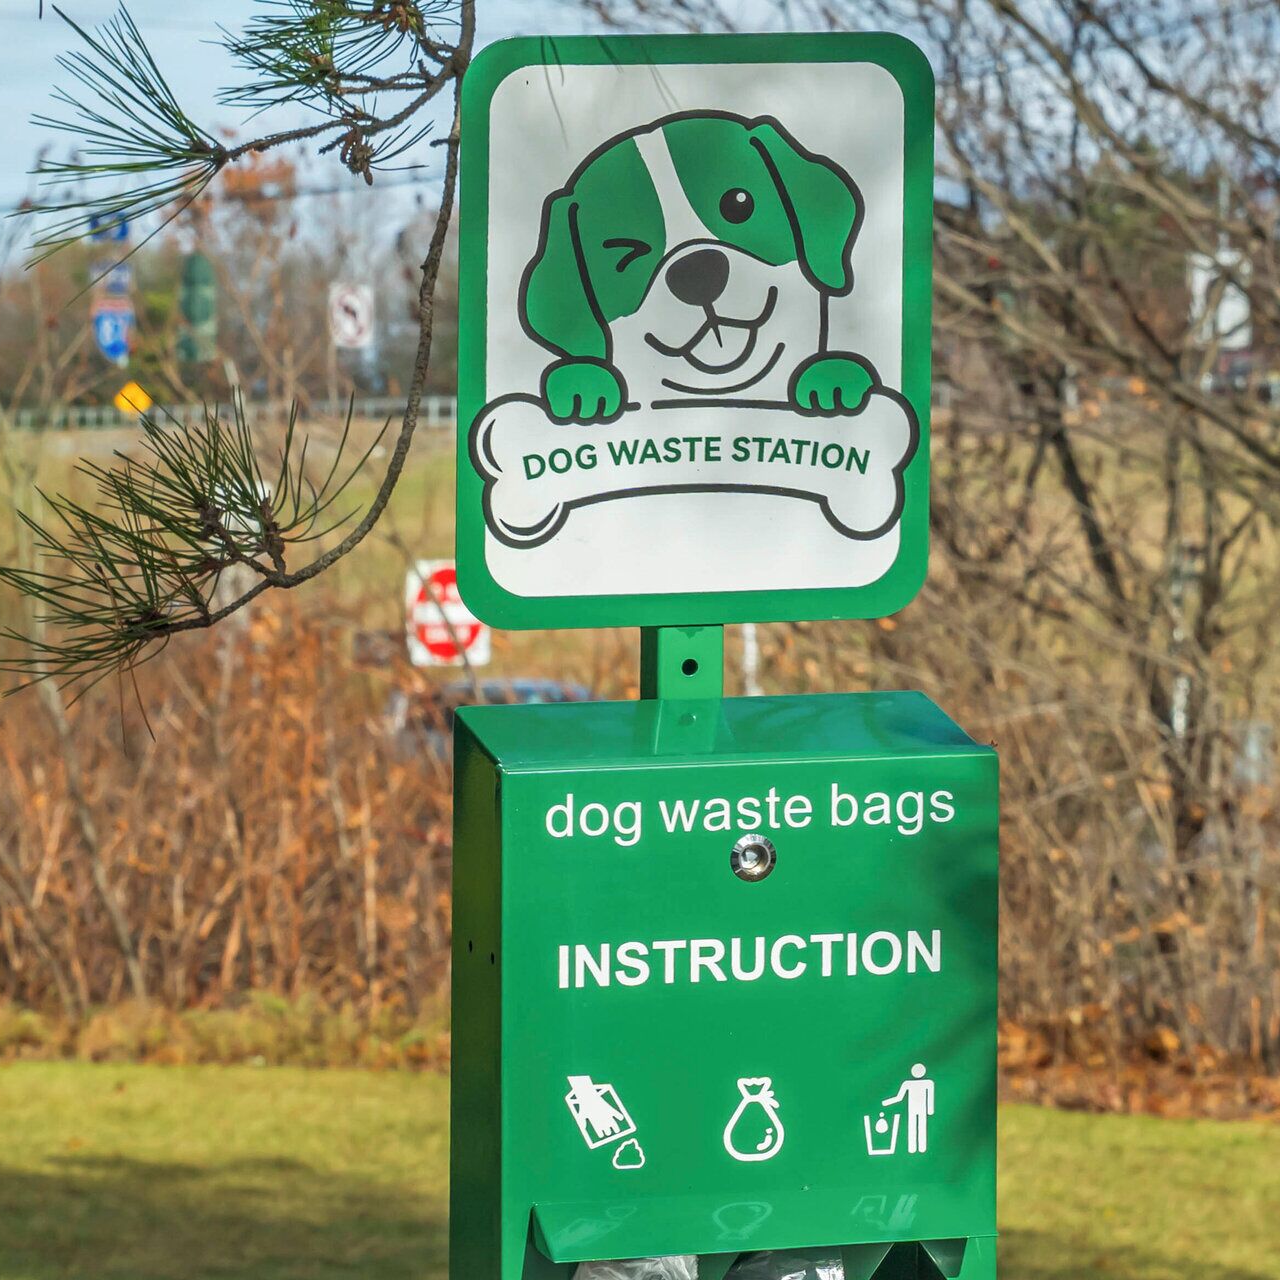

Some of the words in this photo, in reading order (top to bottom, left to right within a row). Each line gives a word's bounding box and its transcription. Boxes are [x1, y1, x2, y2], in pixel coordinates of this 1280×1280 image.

[522, 443, 598, 481] DOG
[606, 436, 722, 466] WASTE
[731, 436, 871, 475] STATION
[545, 793, 642, 847] dog
[658, 786, 813, 833] waste
[830, 782, 956, 836] bags
[558, 929, 942, 989] INSTRUCTION
